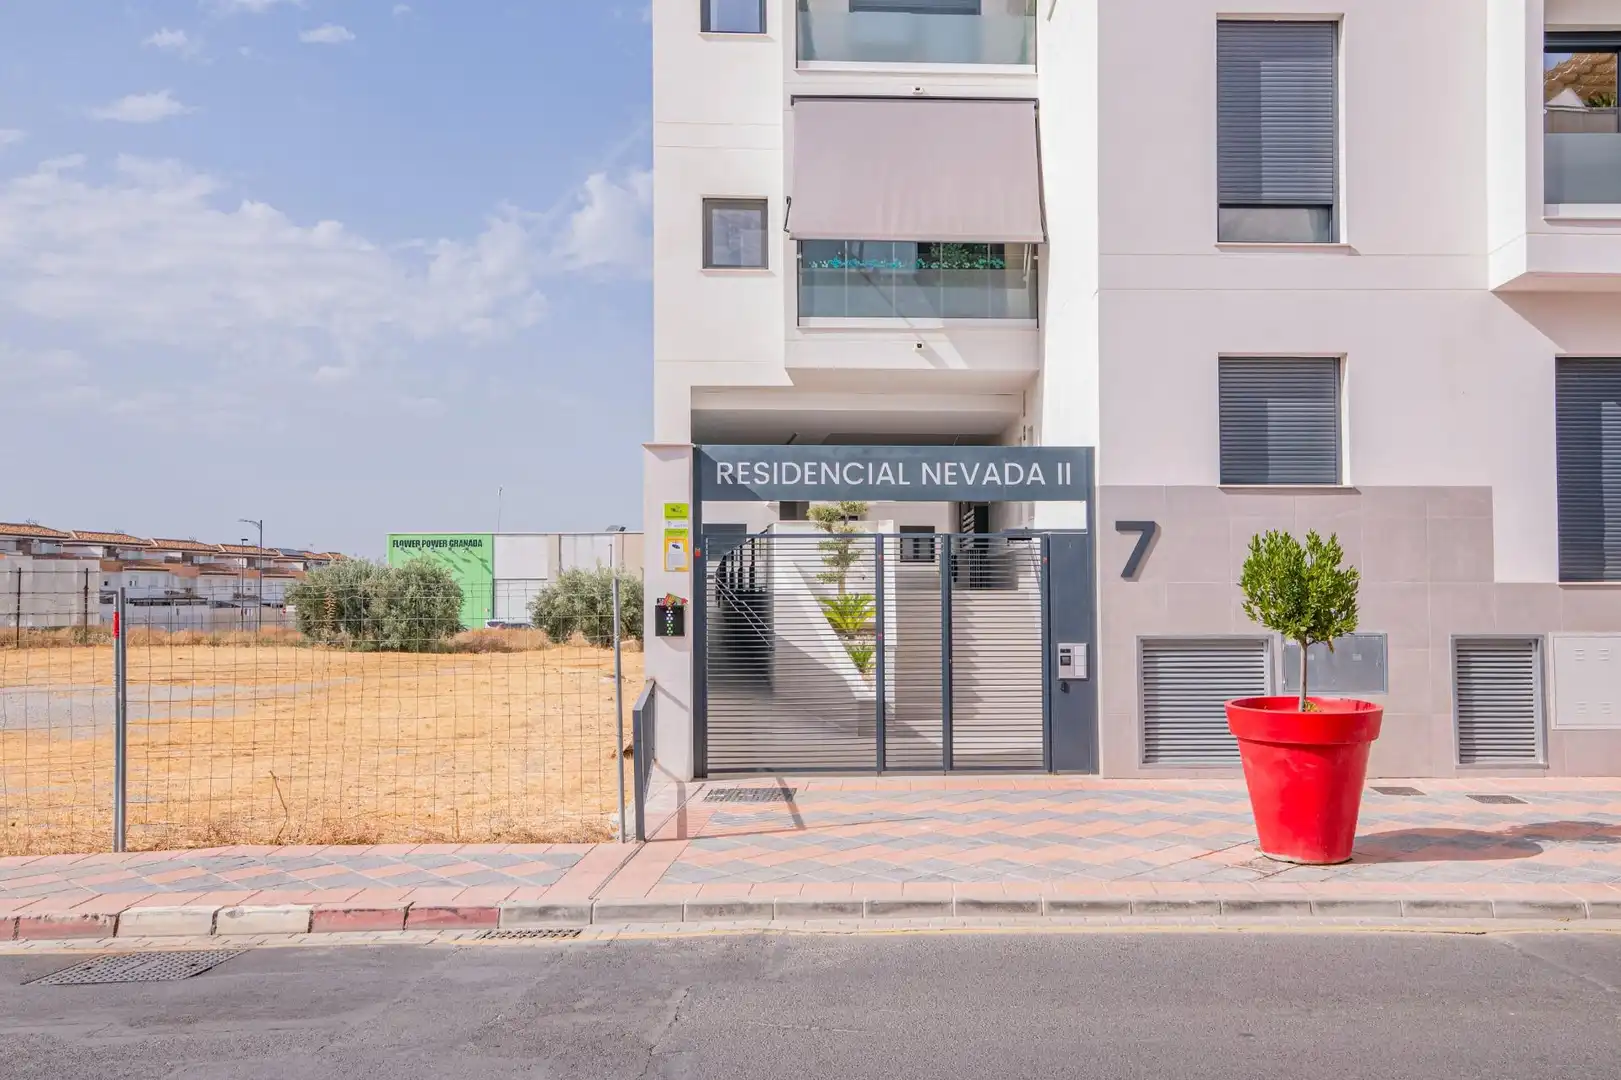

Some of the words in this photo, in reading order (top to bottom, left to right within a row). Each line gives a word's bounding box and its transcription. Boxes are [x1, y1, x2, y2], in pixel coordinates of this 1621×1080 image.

[716, 461, 910, 486] RESIDENCIAL
[921, 461, 1046, 486] NEVADA
[1057, 461, 1072, 486] II
[392, 539, 420, 548] FLOWER
[421, 539, 447, 548] POWER
[449, 539, 483, 548] GRANADA
[1115, 520, 1156, 578] 7
